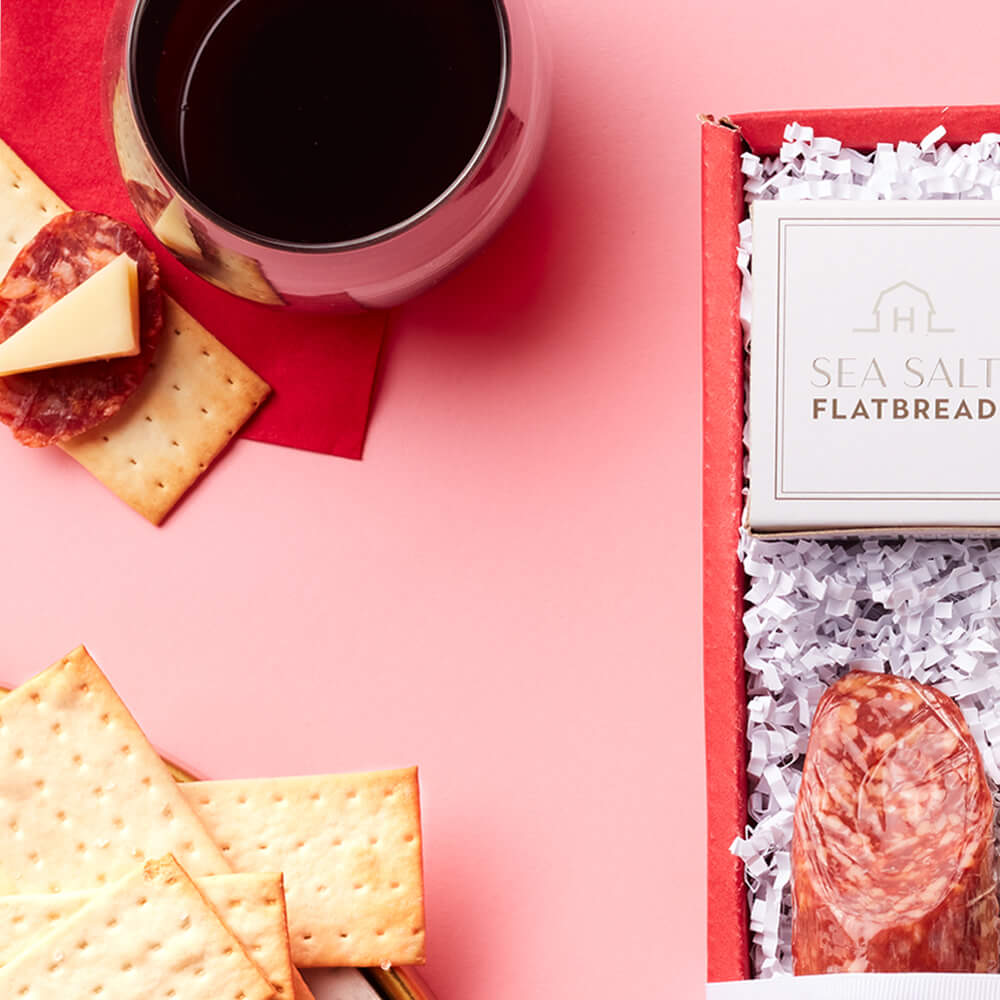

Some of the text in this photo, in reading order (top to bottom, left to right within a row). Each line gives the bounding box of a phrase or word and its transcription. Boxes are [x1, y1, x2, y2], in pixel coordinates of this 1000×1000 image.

[893, 307, 914, 333] H
[811, 356, 1000, 388] SEA SALT
[812, 398, 997, 420] FLATBREAD
